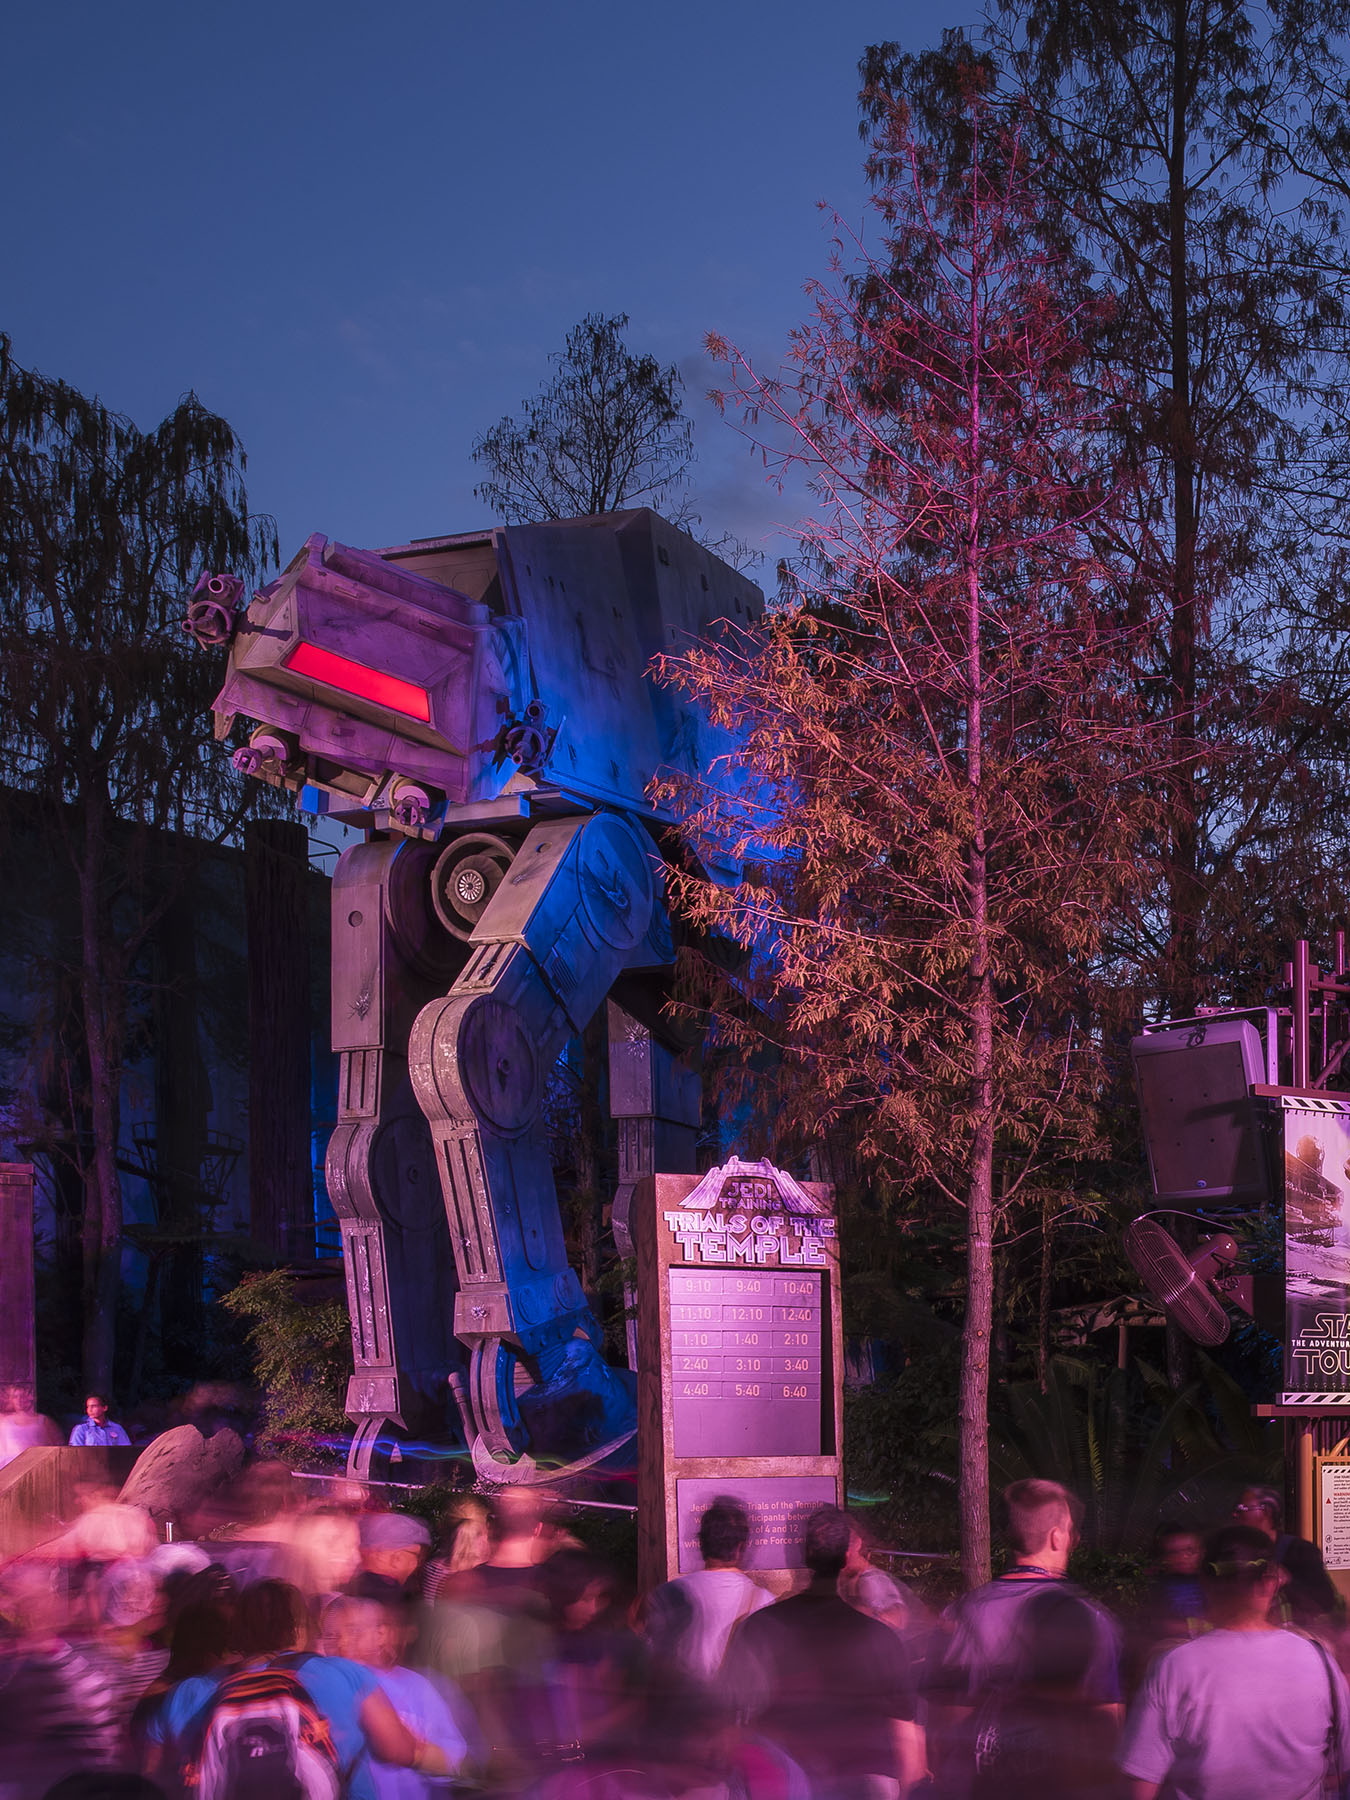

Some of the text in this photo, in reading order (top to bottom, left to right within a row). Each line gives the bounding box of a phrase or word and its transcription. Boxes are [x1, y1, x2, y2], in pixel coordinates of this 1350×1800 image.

[727, 1182, 772, 1199] JEDI
[719, 1197, 782, 1211] TRAINING
[663, 1210, 836, 1238] TRIALS OF THE
[676, 1232, 826, 1265] TEMPLE
[686, 1280, 814, 1294] 9:10 9:40 10:40
[680, 1308, 812, 1321] 11:10 12:10 12:40
[683, 1334, 808, 1346] 1:10 1:40 2:10
[682, 1358, 809, 1371] 2:40 3:10 3:40
[683, 1384, 808, 1398] 4:40 5:40 6:40
[690, 1503, 708, 1512] Jedi
[747, 1502, 769, 1510] Trials
[771, 1500, 780, 1510] of
[780, 1500, 794, 1510] the
[794, 1500, 824, 1511] Temple
[747, 1512, 812, 1524] rticipants betwe
[756, 1526, 763, 1534] of
[765, 1525, 770, 1533] 4
[772, 1524, 787, 1533] and
[789, 1524, 798, 1532] 12
[756, 1538, 768, 1546] are
[770, 1536, 792, 1546] Force
